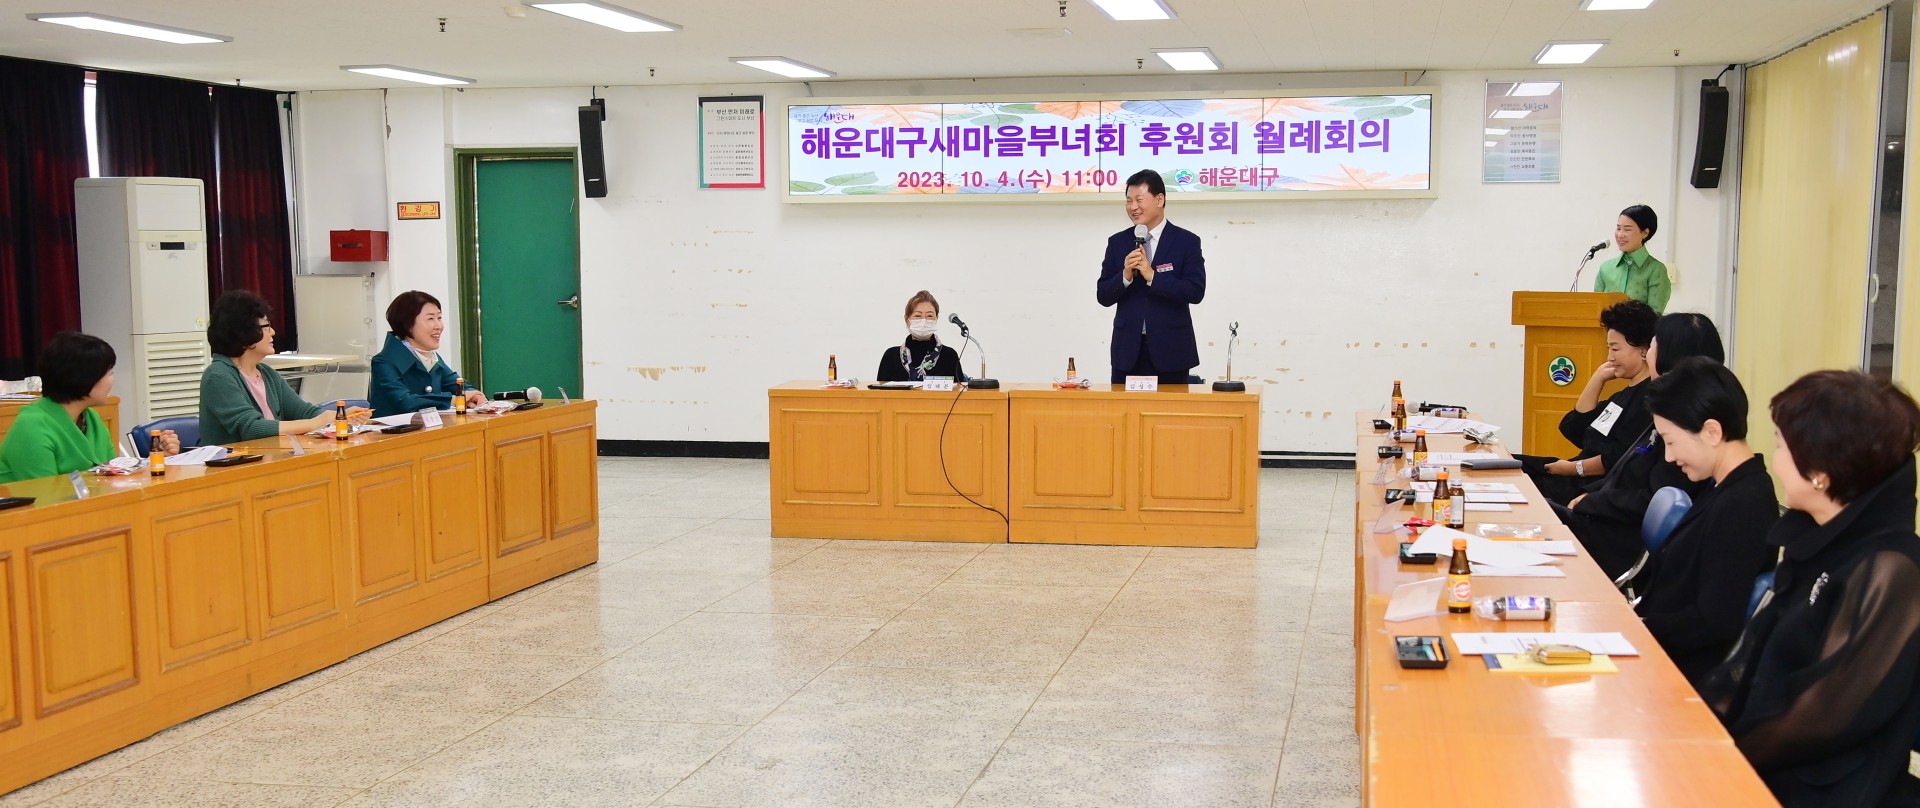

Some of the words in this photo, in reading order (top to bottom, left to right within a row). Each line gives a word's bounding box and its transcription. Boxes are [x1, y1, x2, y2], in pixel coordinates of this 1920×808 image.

[801, 123, 1125, 159] 해운대구새마을부녀회
[1140, 121, 1239, 156] 후원회
[1253, 118, 1390, 154] 월례회의
[897, 171, 952, 188] 2023.
[961, 170, 989, 188] 10.
[1062, 169, 1118, 187] 11:00
[1199, 167, 1280, 187] 해운대구
